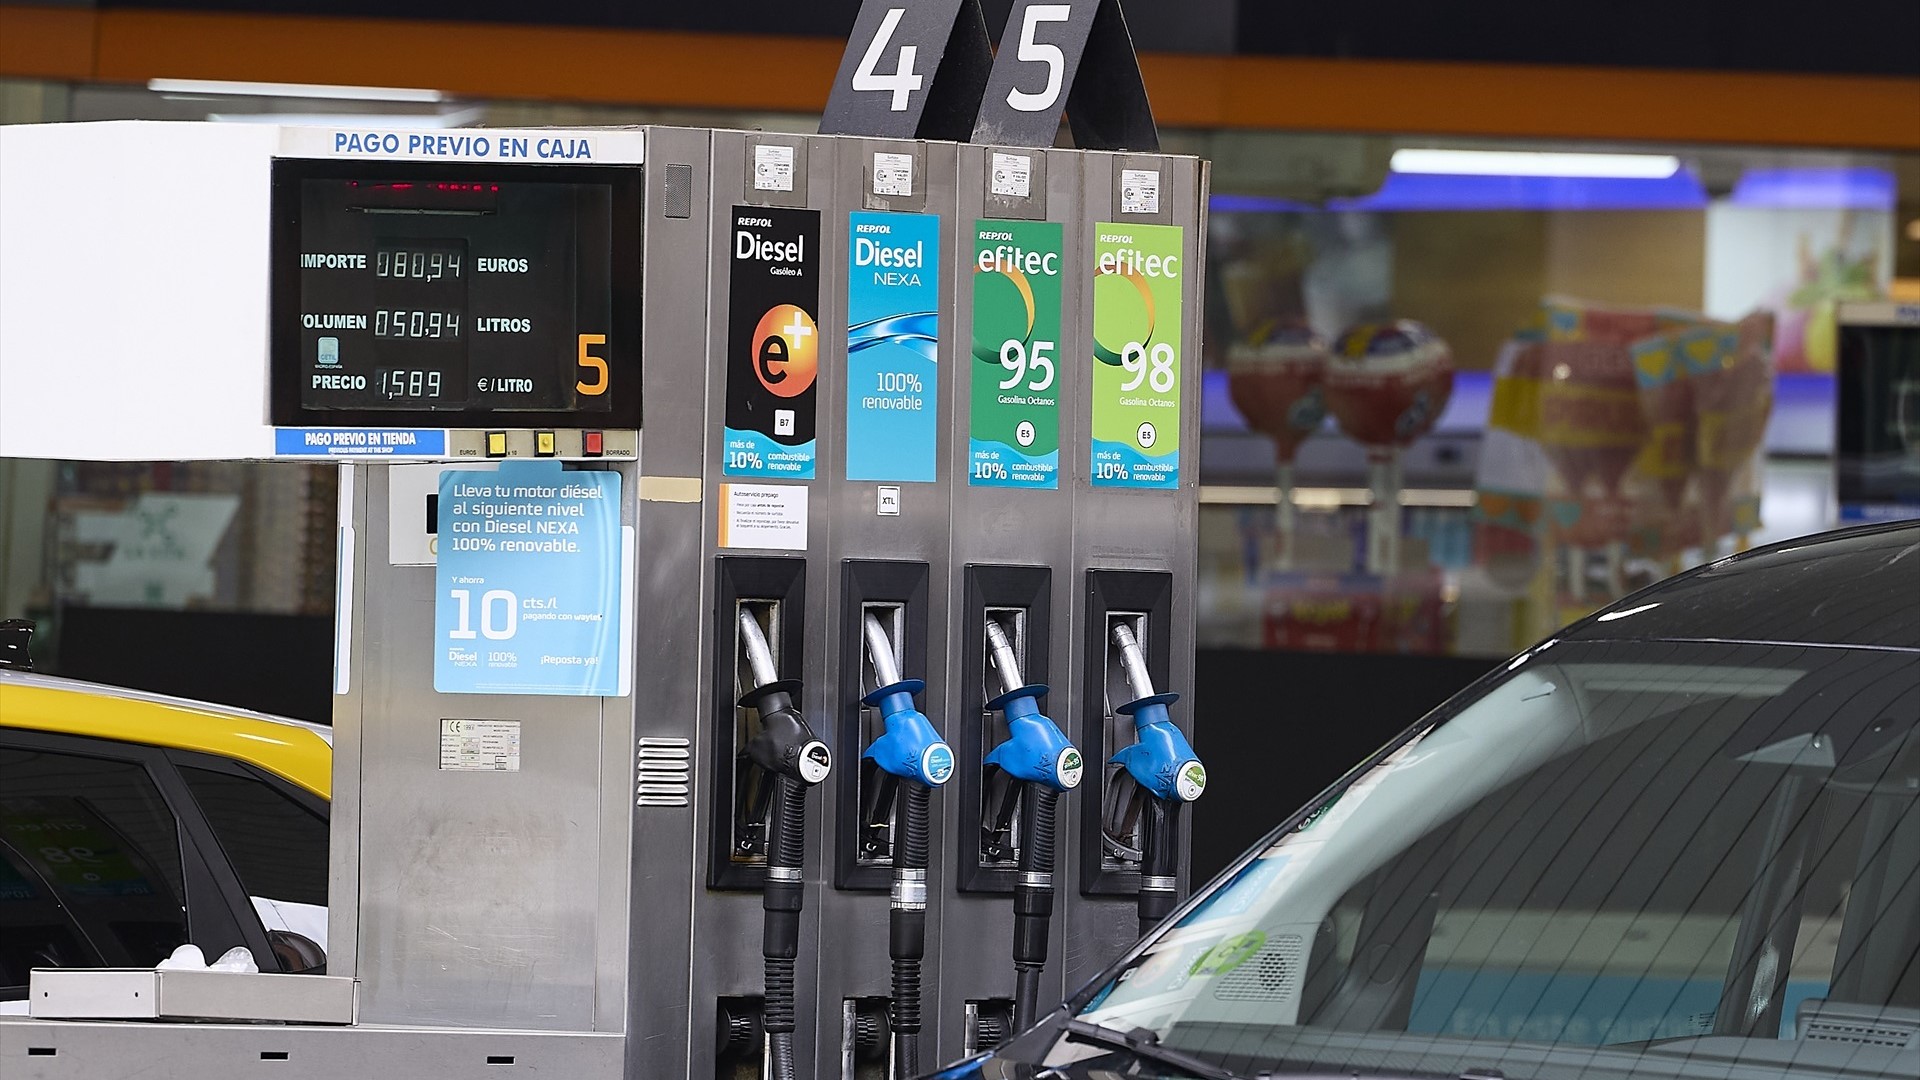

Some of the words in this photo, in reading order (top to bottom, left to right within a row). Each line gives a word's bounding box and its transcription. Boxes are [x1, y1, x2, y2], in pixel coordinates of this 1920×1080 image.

[852, 8, 923, 112] 4
[1006, 4, 1071, 112] 5
[334, 133, 400, 153] PAGO
[408, 134, 490, 157] PREVIO
[499, 138, 528, 157] EN
[537, 138, 592, 159] CAJA
[737, 217, 772, 228] REPSOL
[856, 224, 891, 234] REPSOL
[979, 231, 1013, 241] REPSOL
[1100, 234, 1133, 244] REPSOL
[736, 230, 803, 263] Diesel
[855, 237, 923, 268] Diesel
[300, 253, 367, 270] IMPORTE
[376, 251, 461, 282] 080,94
[477, 257, 529, 273] EUROS
[978, 245, 1058, 276] efitec
[1099, 248, 1178, 278] efitec
[770, 266, 796, 276] Gasóleo
[796, 267, 803, 277] A
[874, 271, 922, 287] NEXA
[375, 310, 460, 338] 050,94
[477, 317, 531, 333] LITROS
[576, 334, 609, 396] 5
[999, 339, 1055, 392] 95
[1120, 341, 1175, 393] 98
[312, 374, 367, 390] PRECIO
[876, 372, 923, 393] 100%
[862, 394, 923, 411] renovable
[998, 394, 1026, 406] Gasolina
[1027, 396, 1055, 407] Octanos
[1119, 396, 1147, 407] Gasolina
[1148, 397, 1175, 408] Octanos
[780, 418, 789, 427] B7
[305, 432, 332, 446] PAGO
[333, 432, 366, 446] PREVIO
[368, 433, 381, 445] EN
[382, 433, 416, 446] TIENDA
[1021, 429, 1030, 438] E5
[1142, 431, 1151, 439] E5
[730, 440, 745, 449] más
[746, 440, 755, 450] de
[729, 451, 763, 470] 10%
[767, 452, 810, 463] combustible
[975, 450, 990, 459] más
[991, 451, 999, 460] de
[1097, 451, 1112, 460] más
[1113, 451, 1121, 460] de
[767, 462, 802, 471] renovable
[974, 462, 1008, 480] 10%
[1012, 463, 1053, 472] combustible
[1096, 462, 1129, 480] 10%
[1133, 463, 1174, 472] combustible
[1012, 472, 1045, 482] renovable
[1133, 472, 1166, 482] renovable
[453, 484, 492, 498] Lleva
[495, 486, 510, 498] tu
[514, 486, 556, 499] motor
[560, 485, 603, 499] diésel
[882, 497, 895, 505] XTL
[453, 502, 468, 515] al
[472, 502, 543, 518] siguiente
[547, 502, 585, 517] nivel
[452, 521, 480, 534] con
[485, 520, 532, 534] Diesel
[536, 521, 579, 535] NEXA
[452, 537, 496, 551] 100%
[500, 538, 580, 553] renovable.
[452, 576, 458, 584] Y
[459, 576, 485, 584] ahorra
[449, 589, 518, 640] 10
[522, 612, 556, 622] pagando
[558, 612, 572, 621] con
[449, 651, 478, 661] Diesel
[488, 652, 517, 662] 100%
[540, 655, 582, 666] ¡Reposta
[584, 656, 599, 667] ya!
